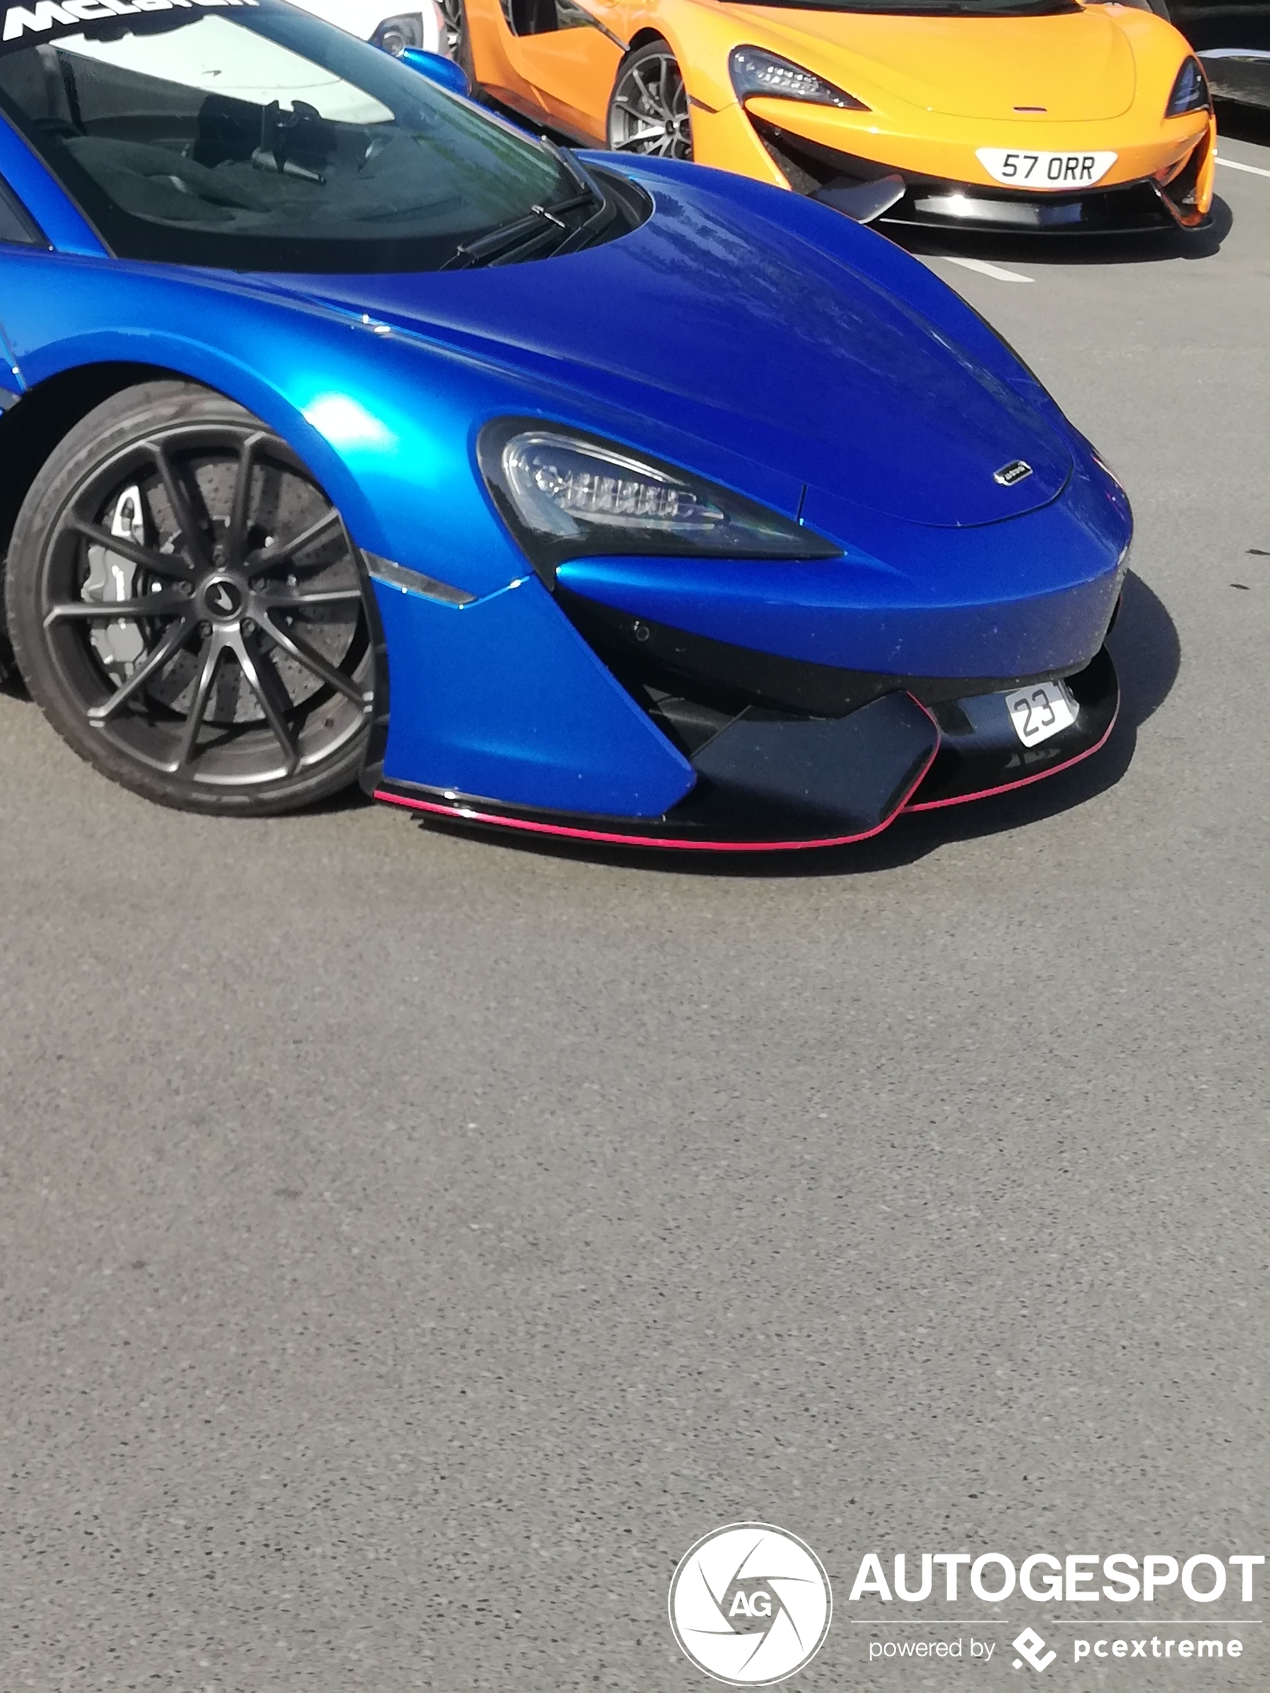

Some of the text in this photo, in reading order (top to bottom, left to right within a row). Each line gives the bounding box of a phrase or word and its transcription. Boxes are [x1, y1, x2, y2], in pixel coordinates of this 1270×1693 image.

[1001, 154, 1096, 181] 57 ORR
[1014, 689, 1056, 738] 23
